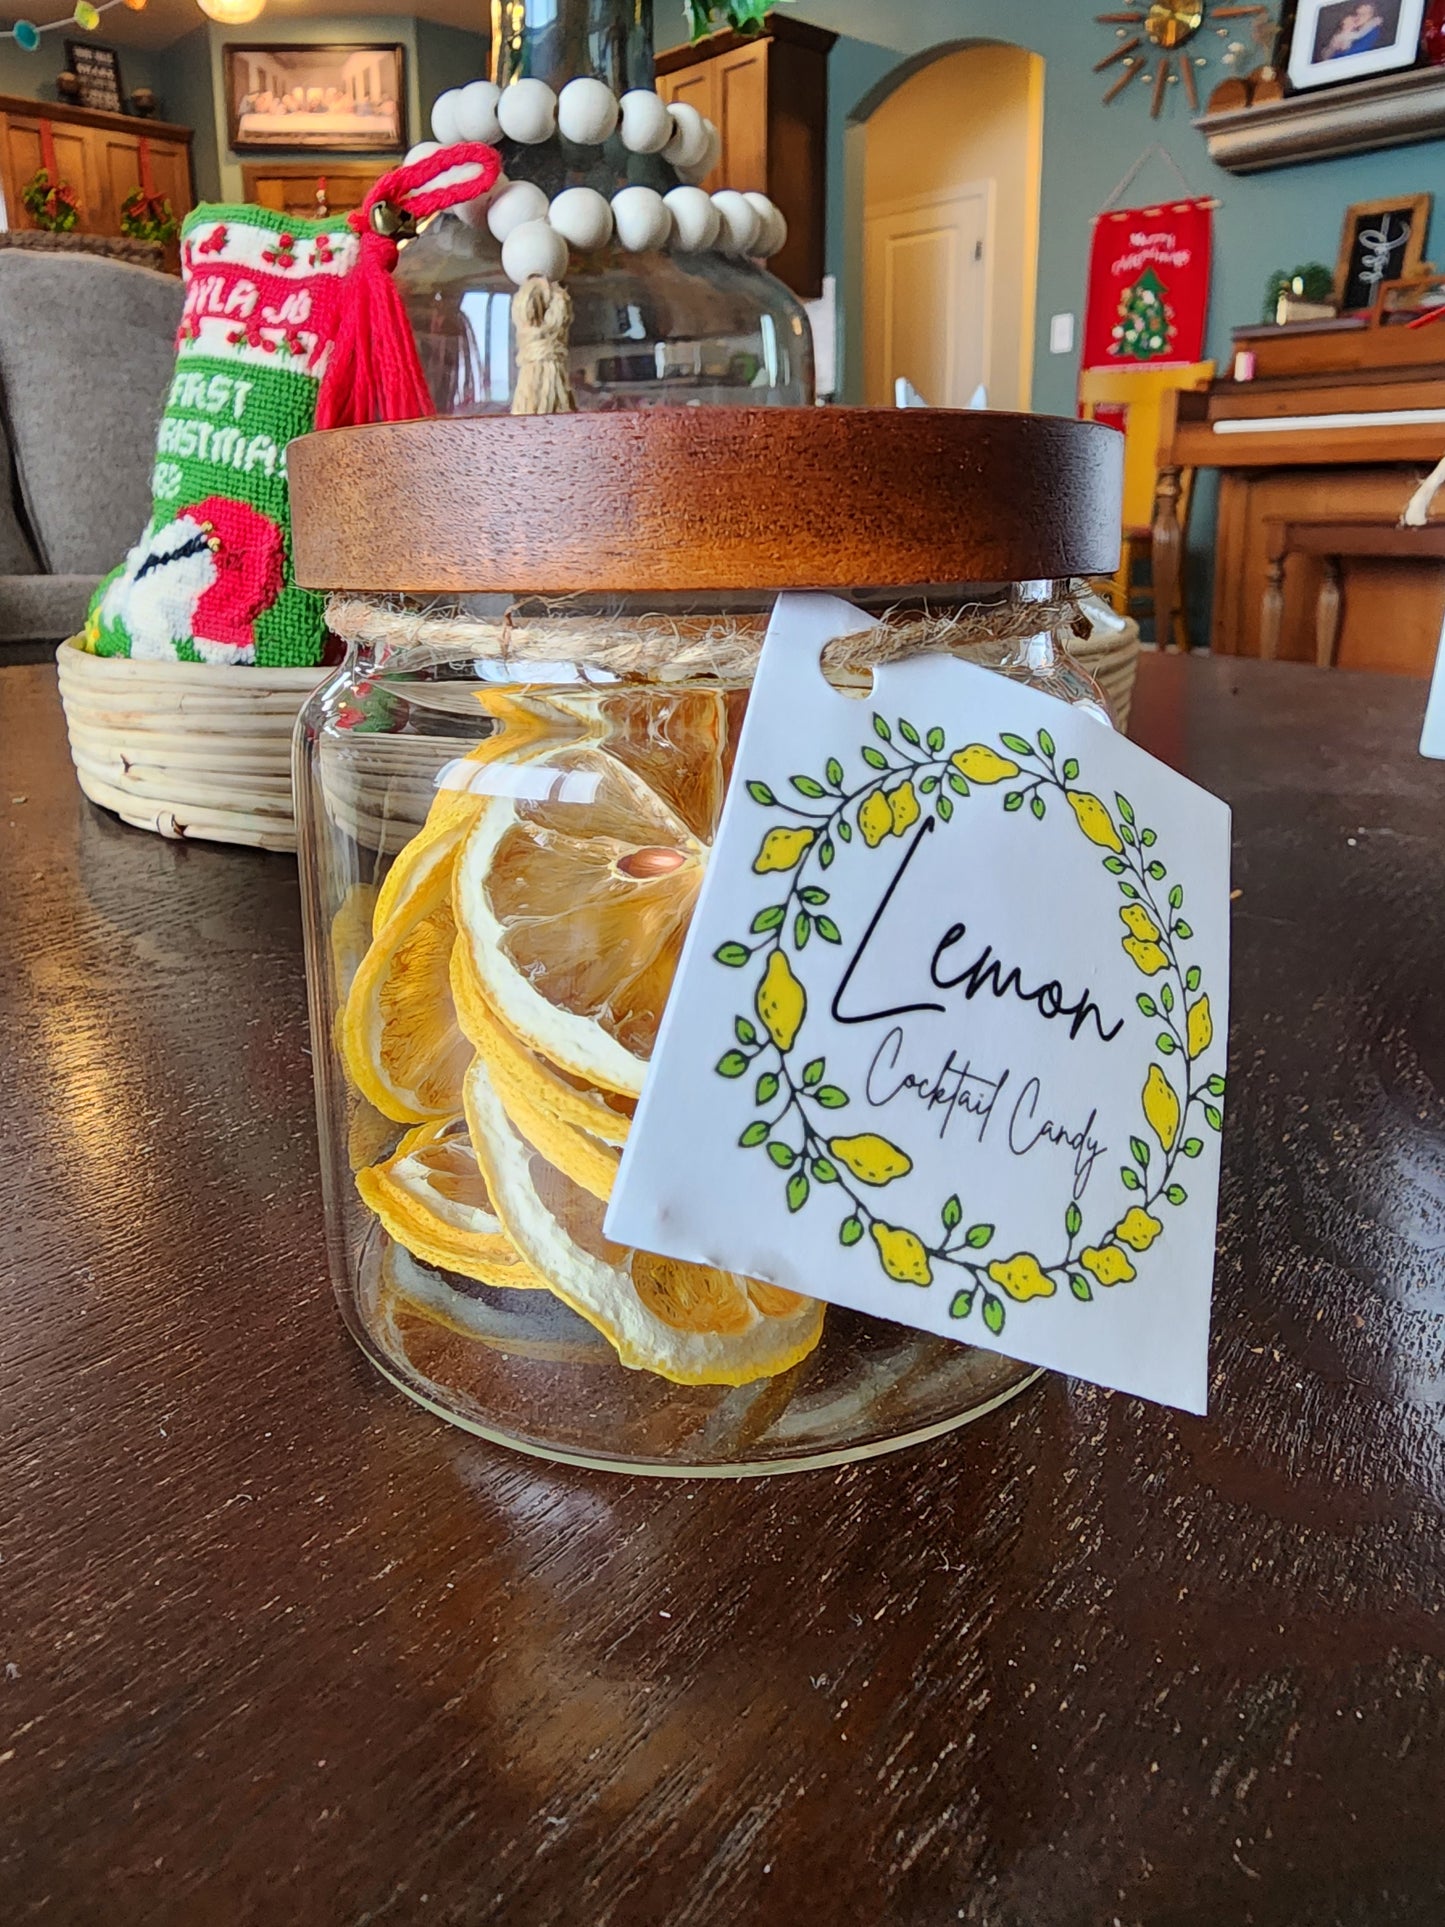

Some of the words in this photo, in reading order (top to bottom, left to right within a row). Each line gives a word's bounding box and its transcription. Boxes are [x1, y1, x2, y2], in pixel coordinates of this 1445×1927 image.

[831, 815, 1124, 1042] Lemon
[866, 1026, 1010, 1143] Cocktail
[1009, 1077, 1108, 1201] Candy
